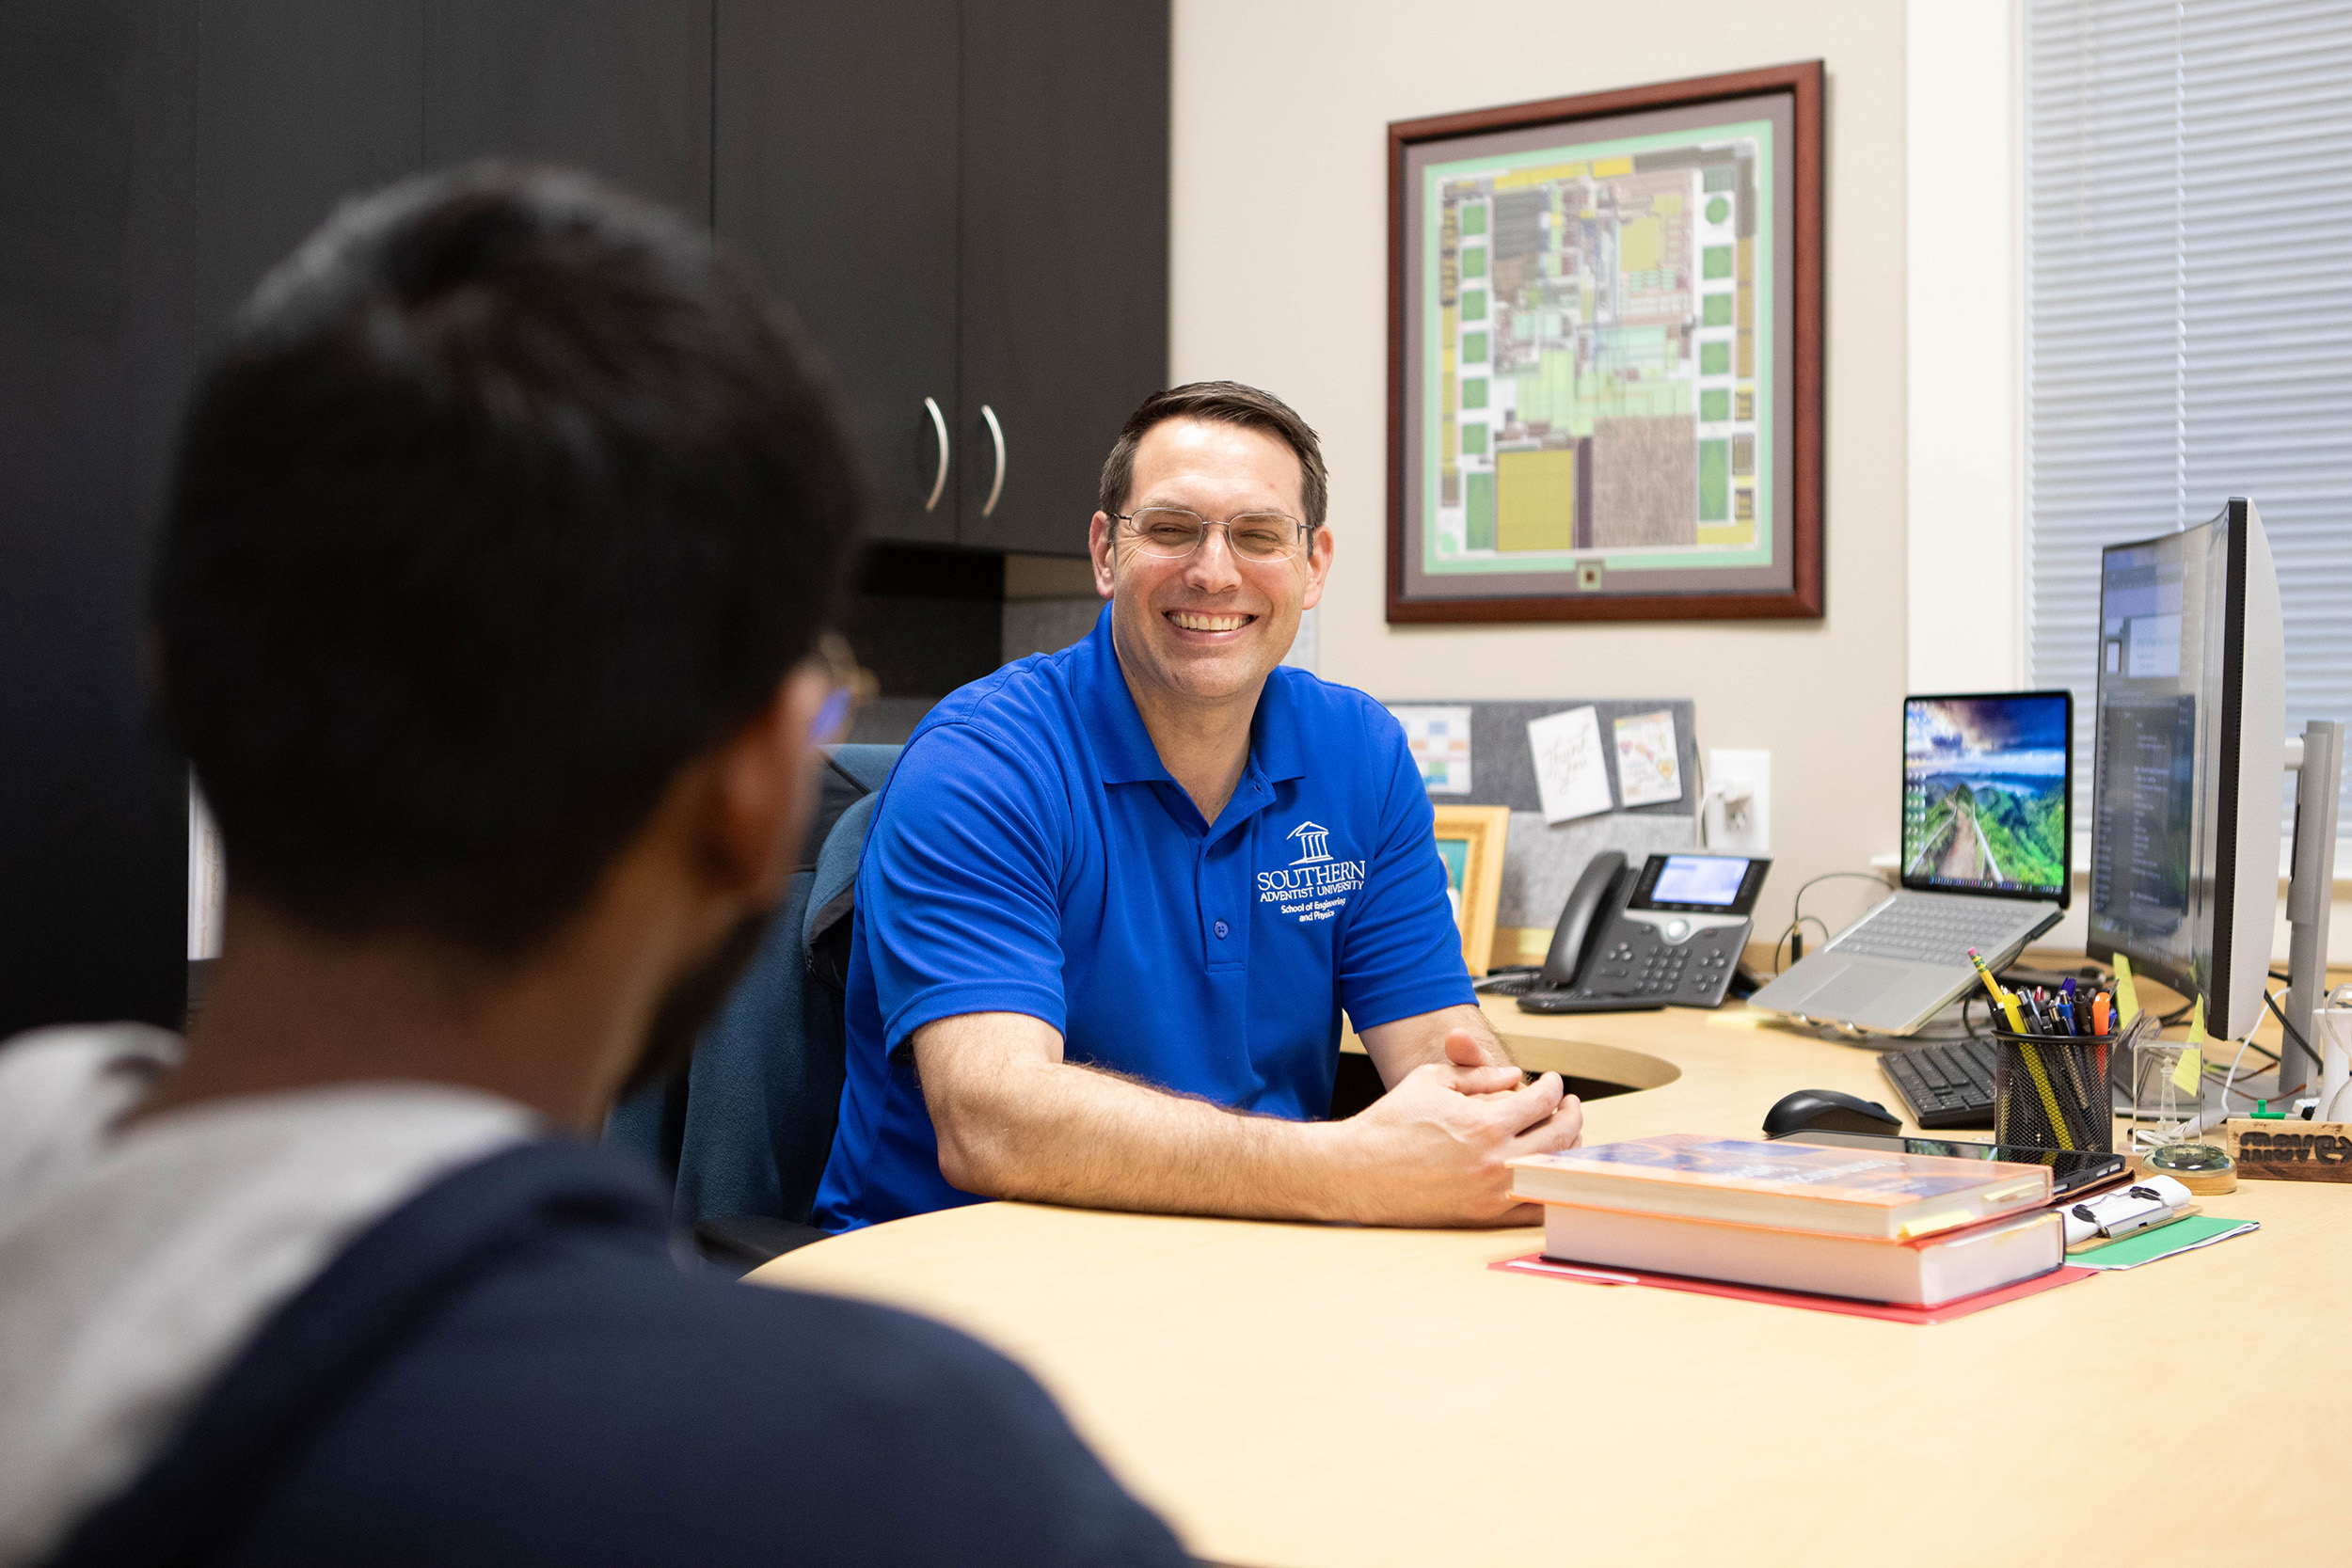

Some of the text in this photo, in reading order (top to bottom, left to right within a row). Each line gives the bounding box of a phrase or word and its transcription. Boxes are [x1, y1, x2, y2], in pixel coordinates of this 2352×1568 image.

[1257, 860, 1366, 891] SOUTHERN
[1260, 880, 1365, 902] ADVENTIST UNIVERSITY
[1280, 896, 1346, 914] School of Engineering
[1299, 909, 1335, 922] and Physics
